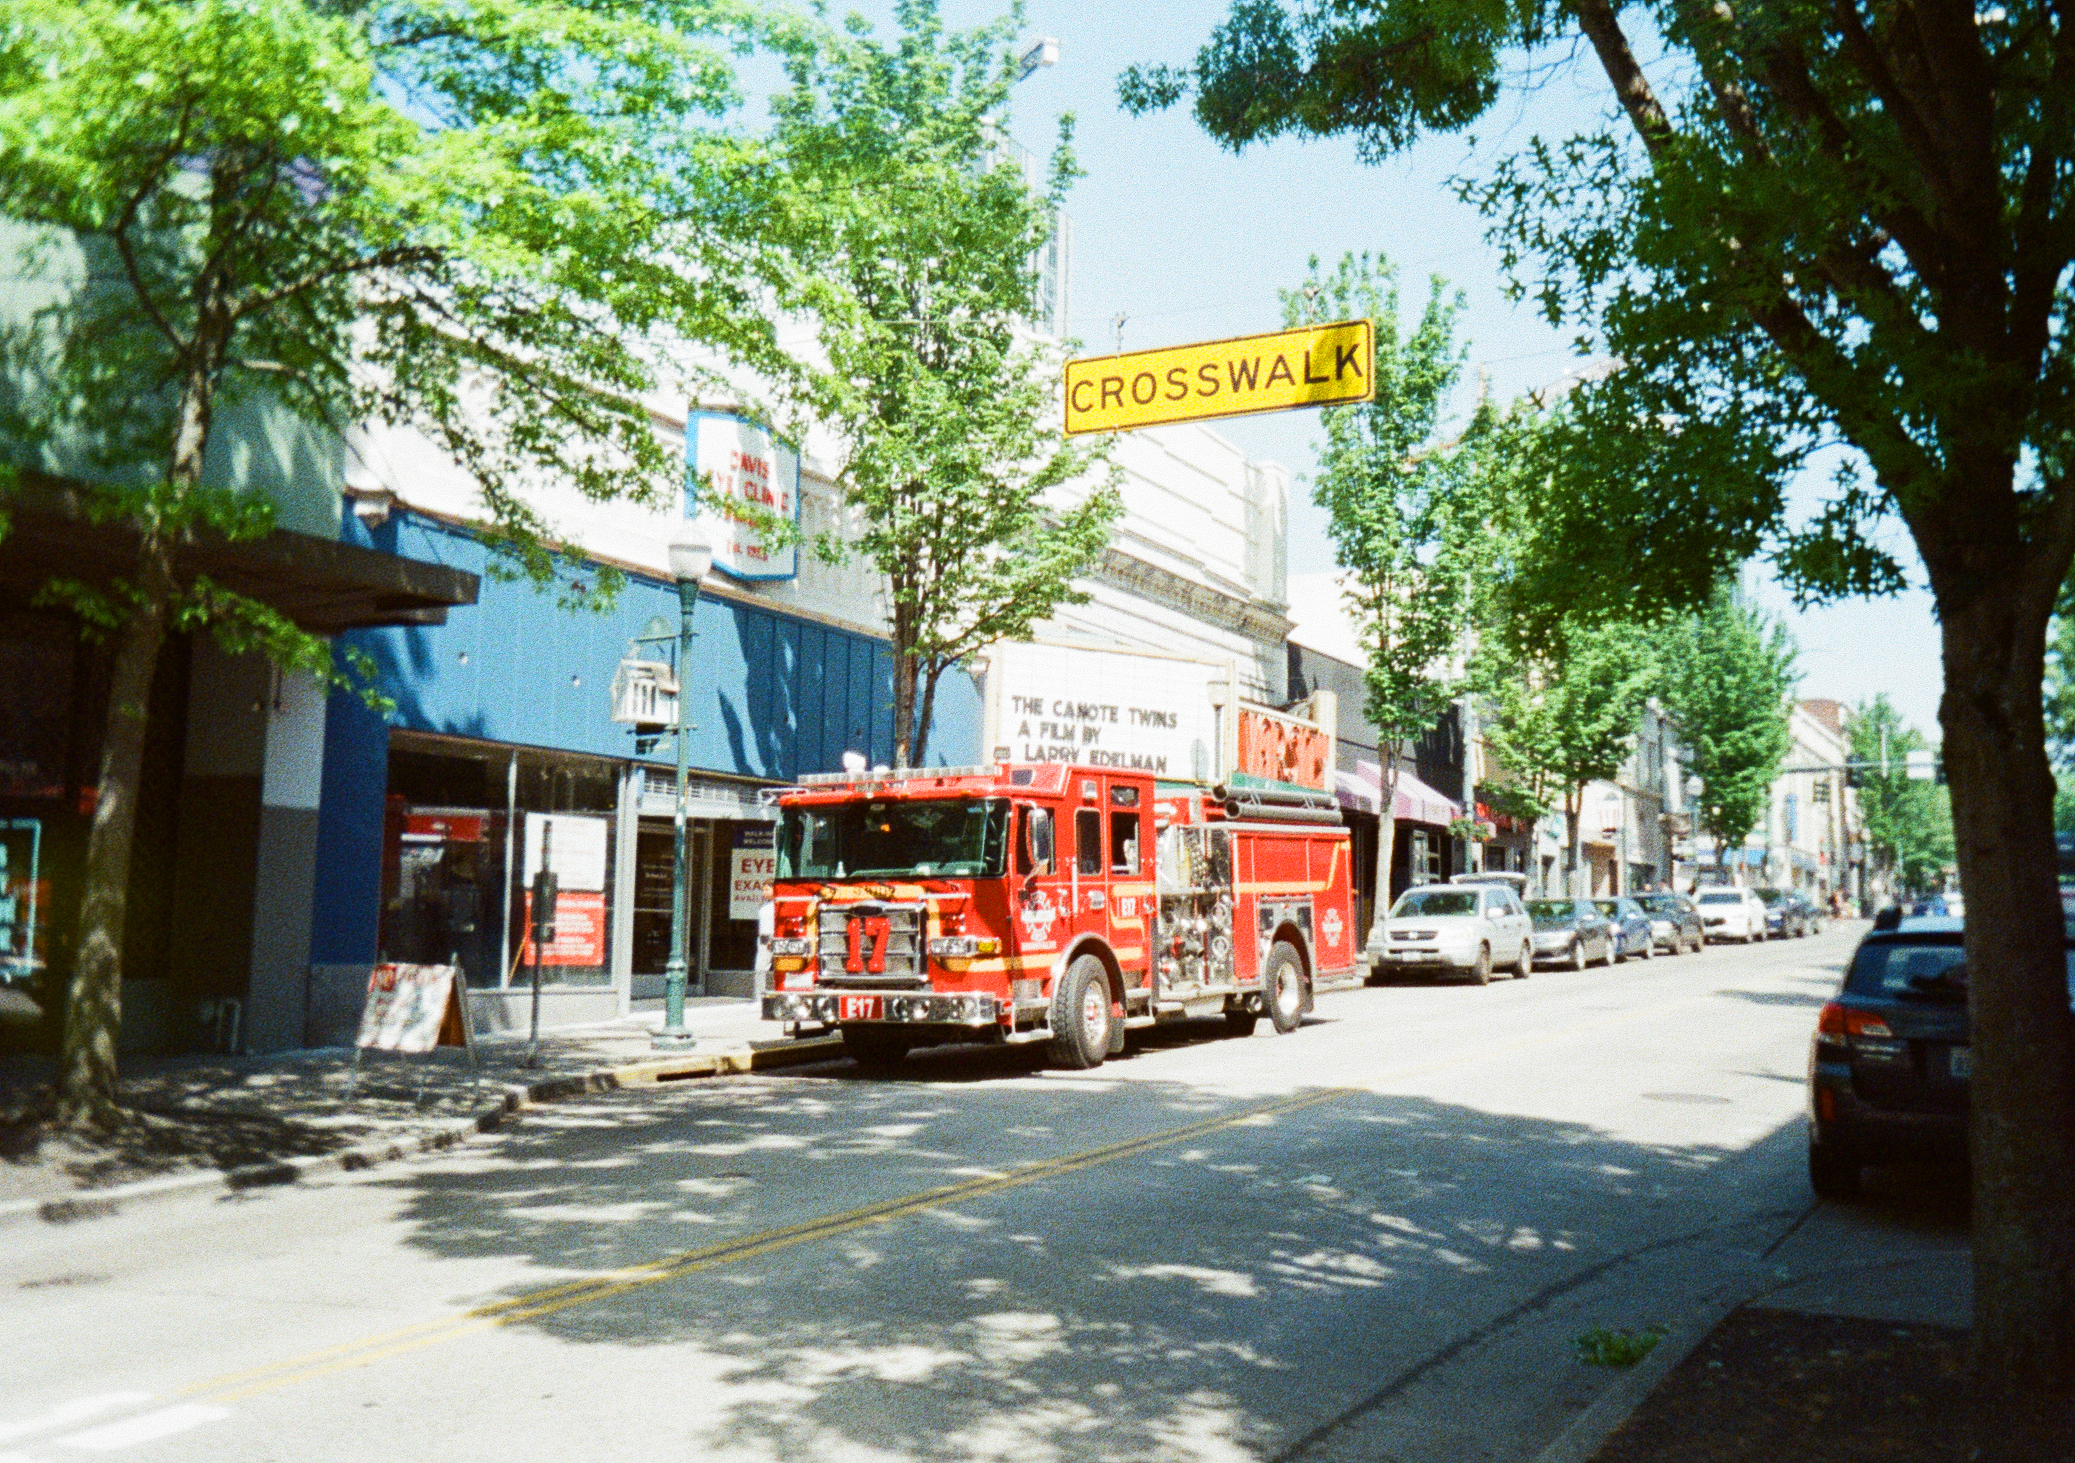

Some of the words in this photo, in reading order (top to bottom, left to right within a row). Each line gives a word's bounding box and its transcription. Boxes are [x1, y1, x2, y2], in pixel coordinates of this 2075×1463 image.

[1071, 343, 1363, 413] CROSSWALK
[731, 450, 769, 480] DAVIS
[744, 481, 788, 511] CLINIC
[1012, 695, 1043, 716] THE
[1053, 700, 1118, 723] CANOTE
[1128, 707, 1177, 729] TWINS
[1017, 720, 1030, 737] A
[1040, 722, 1075, 742] FILM
[1082, 727, 1101, 744] BY
[1090, 750, 1167, 774] EDELMAN
[741, 858, 775, 873] EYE
[846, 917, 890, 973] 17
[847, 998, 874, 1019] E17
